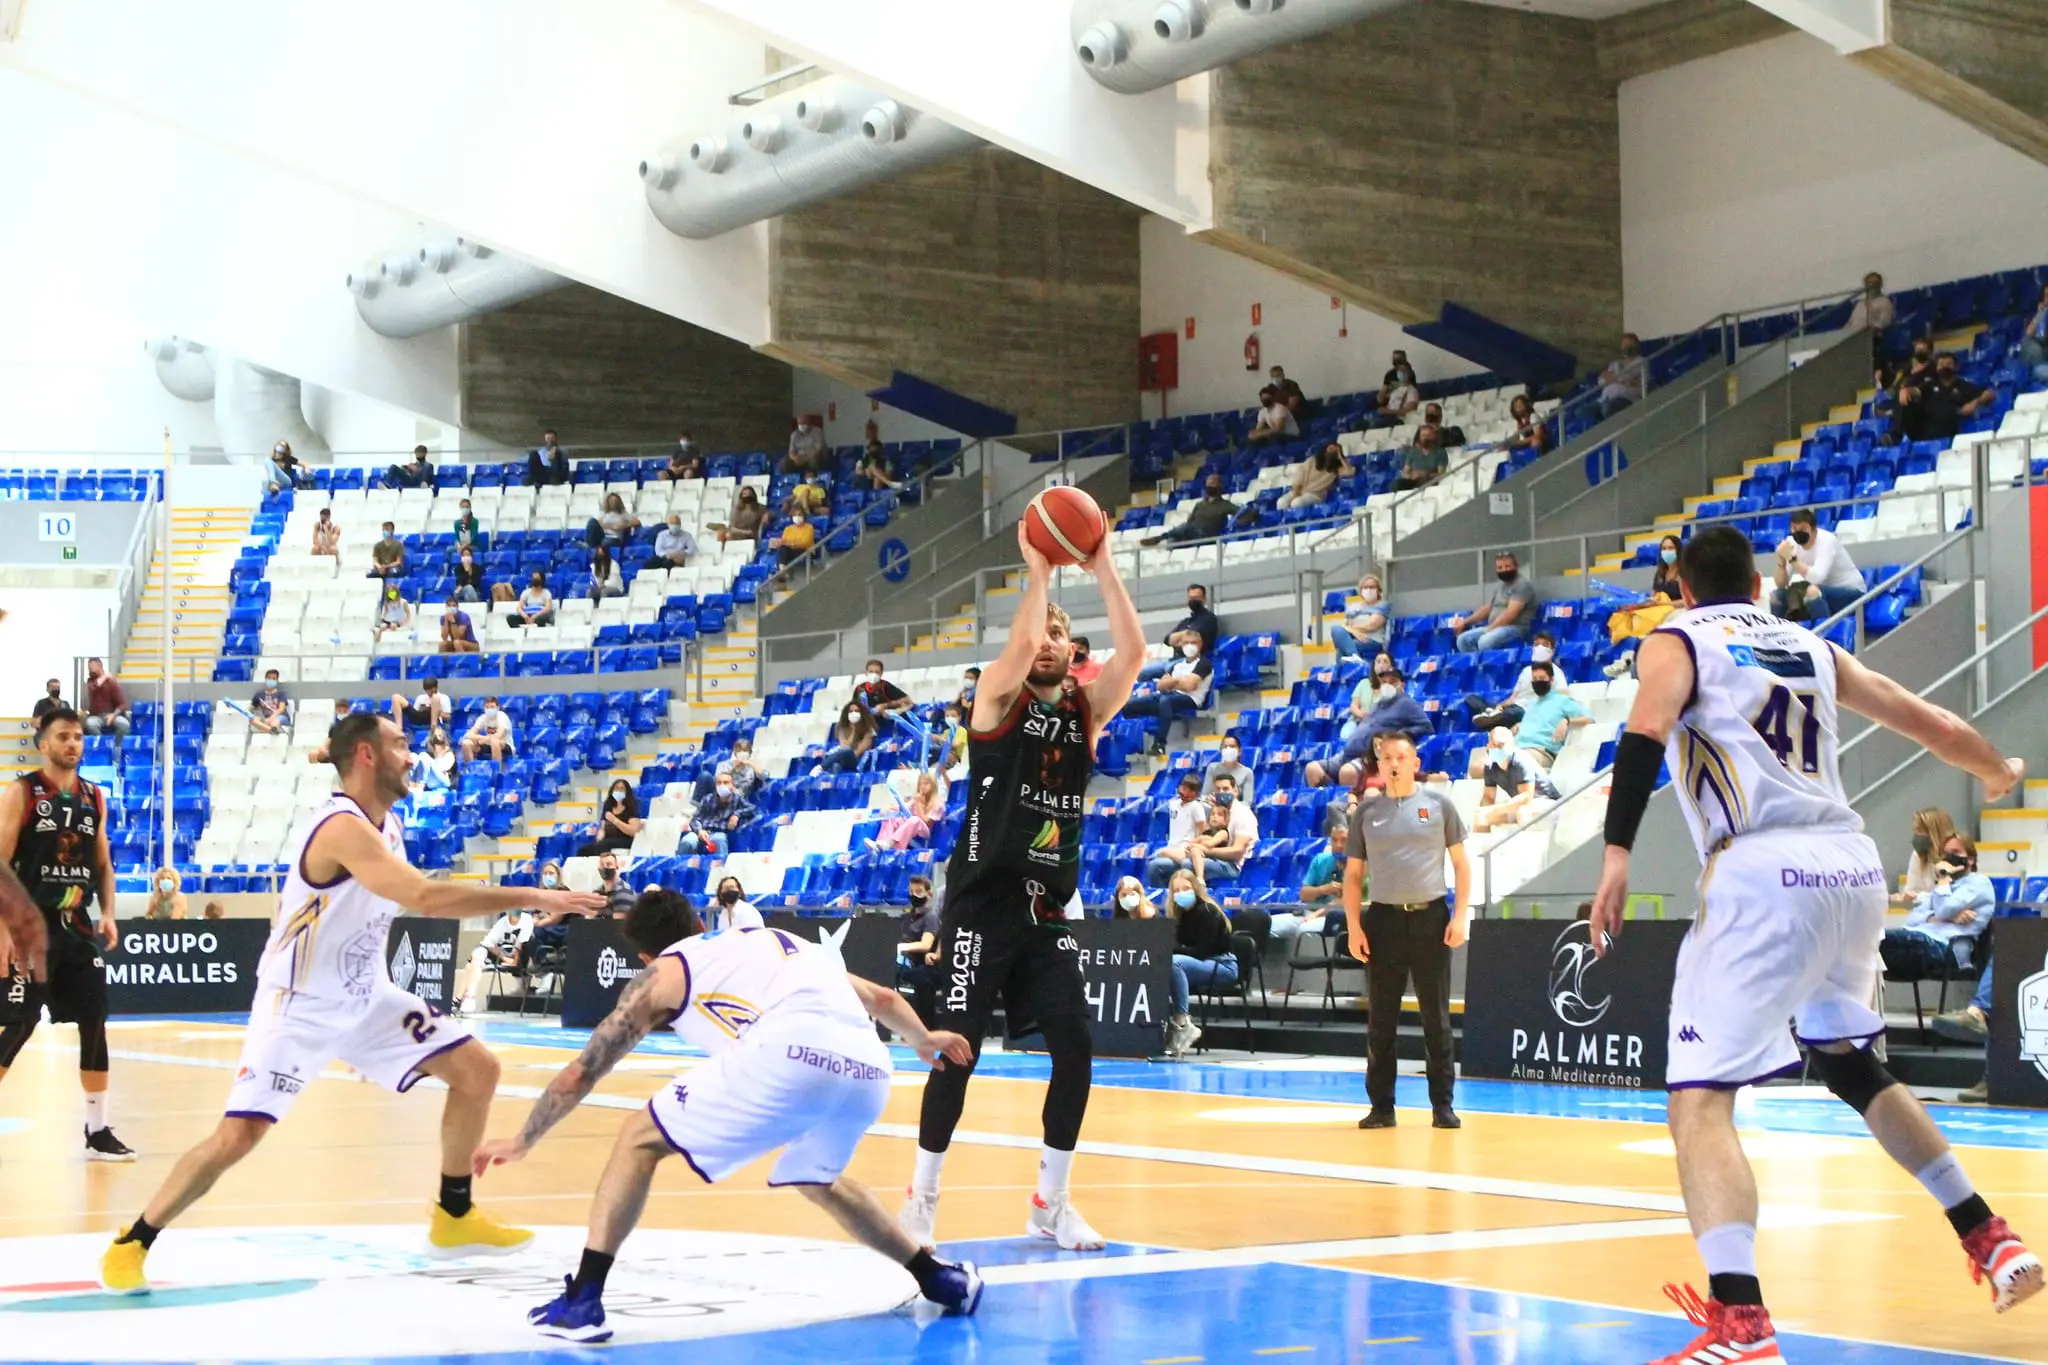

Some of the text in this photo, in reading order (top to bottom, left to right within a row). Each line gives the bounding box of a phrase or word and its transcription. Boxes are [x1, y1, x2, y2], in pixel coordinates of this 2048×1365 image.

[44, 518, 71, 536] 10
[885, 547, 902, 575] K
[1753, 684, 1820, 773] 41
[62, 806, 73, 828] 7
[123, 932, 218, 955] GRUPO
[418, 937, 452, 961] FUNDACIÓ
[971, 933, 984, 967] GROUP
[946, 927, 976, 1012] ibacar
[1080, 949, 1151, 966] RENTA
[105, 962, 238, 985] MIRALLES
[417, 962, 443, 980] PALMA
[414, 981, 443, 1000] FUTSAL
[1085, 981, 1152, 1023] HIA
[1512, 1028, 1643, 1067] PALMER
[1511, 1063, 1641, 1087] Alma Mediterránea
